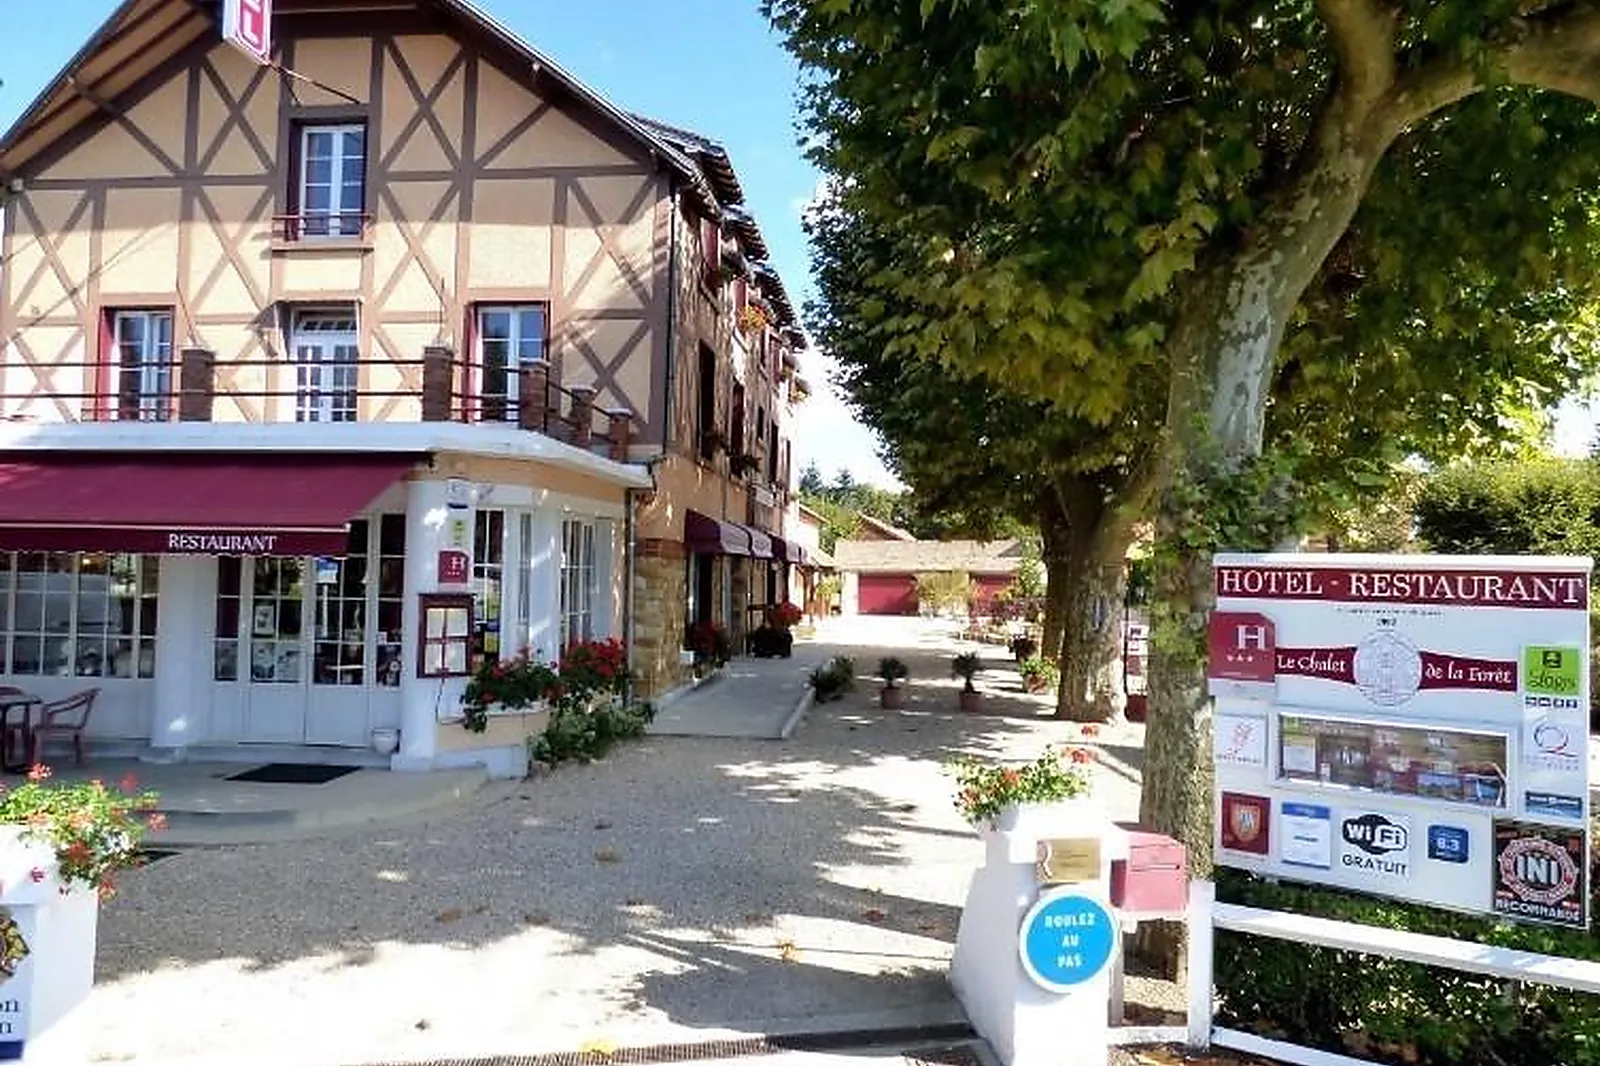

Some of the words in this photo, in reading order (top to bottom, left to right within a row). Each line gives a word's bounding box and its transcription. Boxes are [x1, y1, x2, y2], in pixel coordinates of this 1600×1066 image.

[169, 533, 277, 550] RESTAURANT
[451, 556, 466, 571] H
[1220, 569, 1323, 595] HOTEL
[1350, 573, 1583, 603] RESTAURANT
[1237, 625, 1266, 650] H
[1277, 655, 1295, 669] Le
[1297, 650, 1347, 672] Chalet
[1425, 663, 1443, 678] de
[1447, 660, 1463, 680] la
[1437, 837, 1460, 852] 8.3
[1342, 854, 1407, 875] GRATUIT
[1044, 913, 1096, 929] ROULEZ
[1062, 934, 1079, 947] AU
[1057, 955, 1082, 968] PAS
